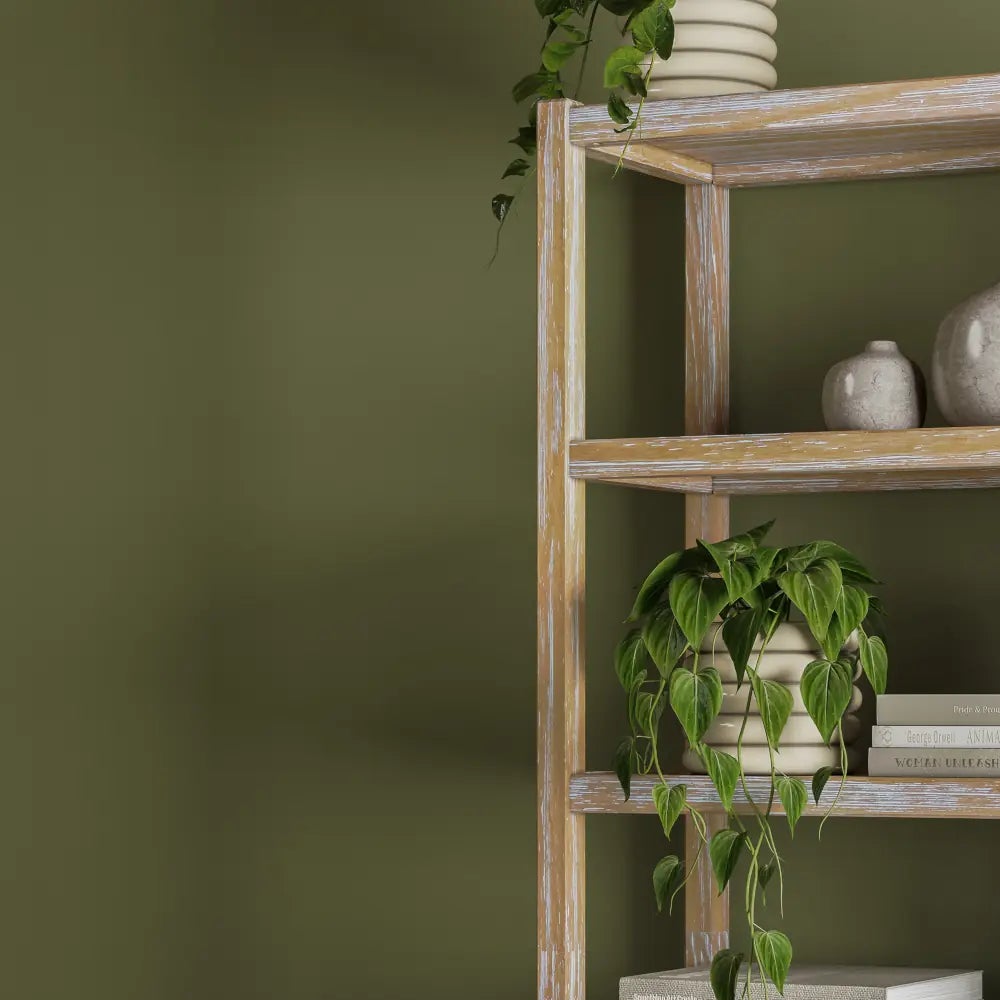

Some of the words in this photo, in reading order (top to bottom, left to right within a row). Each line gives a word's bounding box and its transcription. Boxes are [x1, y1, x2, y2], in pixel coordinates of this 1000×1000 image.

[953, 705, 972, 714] Pride
[975, 705, 981, 714] &
[895, 758, 940, 768] WOMAN
